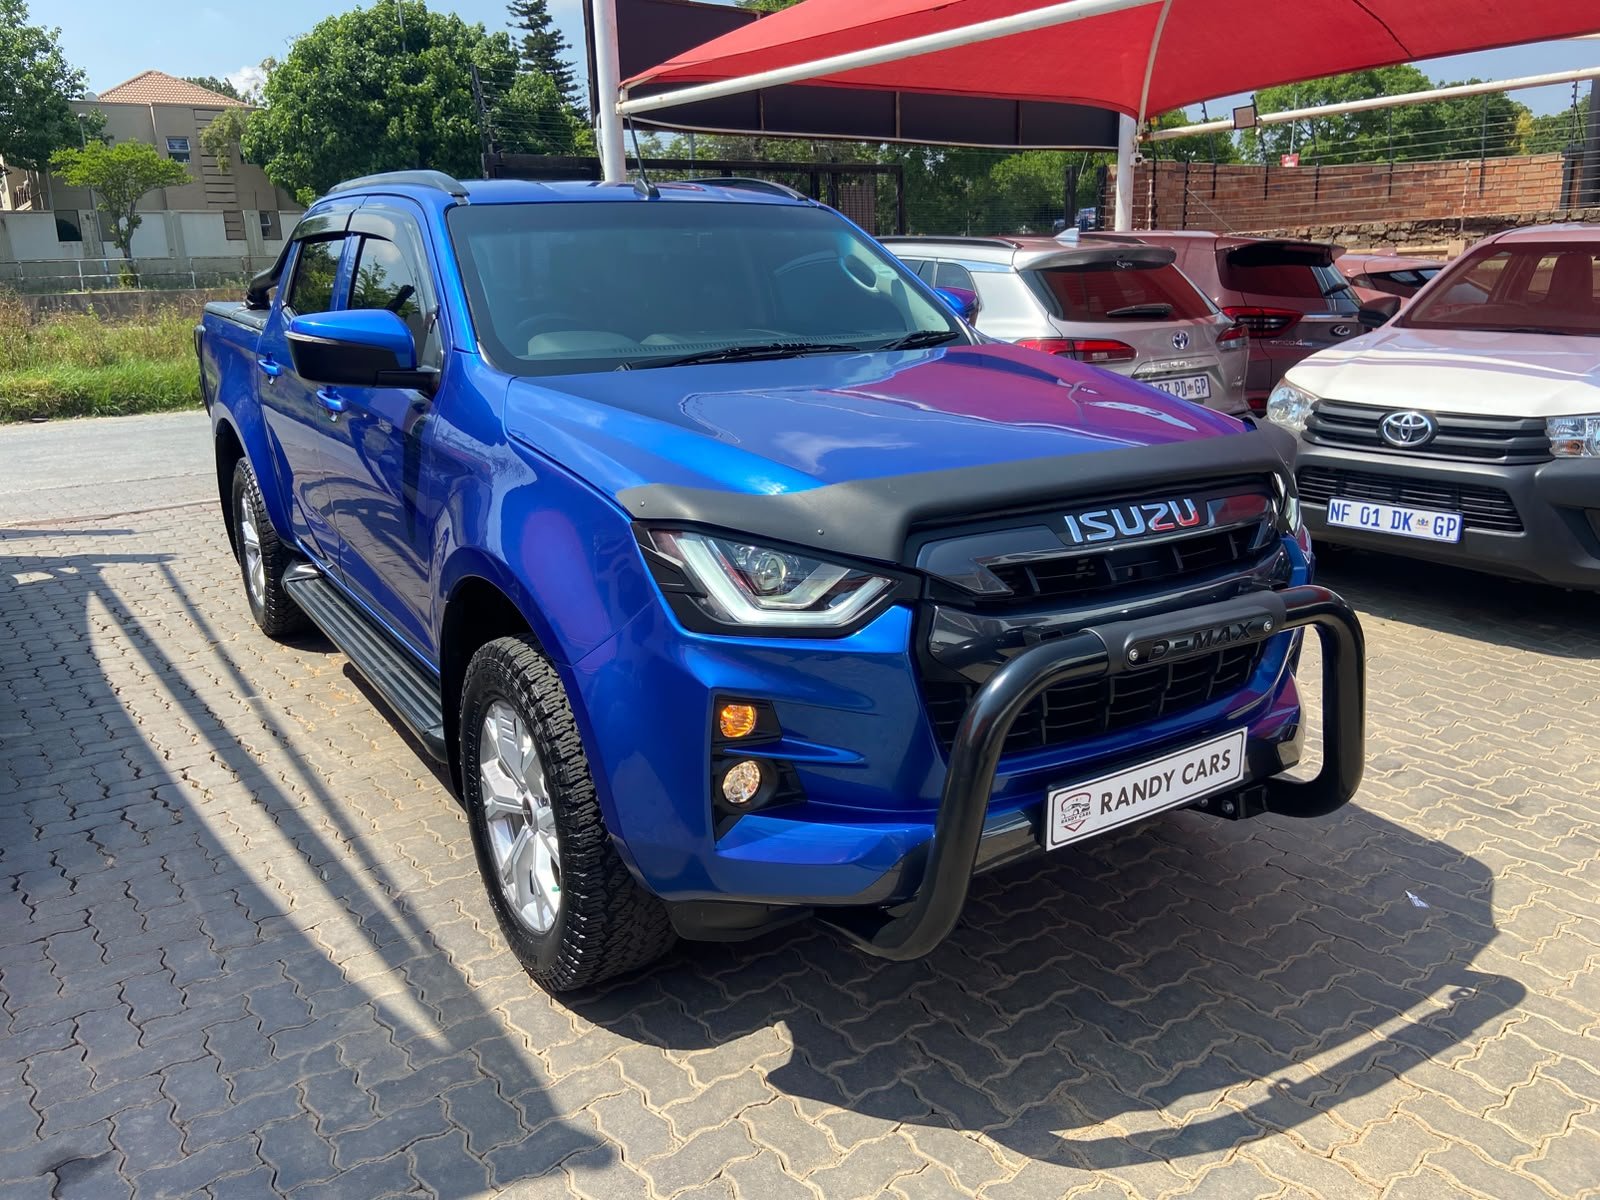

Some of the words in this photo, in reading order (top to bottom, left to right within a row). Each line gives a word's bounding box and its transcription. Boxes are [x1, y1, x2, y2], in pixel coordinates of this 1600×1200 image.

[1174, 381, 1187, 397] PD
[1194, 378, 1206, 395] GP
[1064, 498, 1200, 543] ISUZU
[1330, 502, 1352, 522] NF
[1359, 506, 1380, 527] 01
[1390, 510, 1414, 532] DK
[1432, 516, 1457, 537] GP
[1148, 621, 1252, 660] D-MAX
[1100, 769, 1176, 815] RANDY
[1181, 749, 1231, 785] CARS
